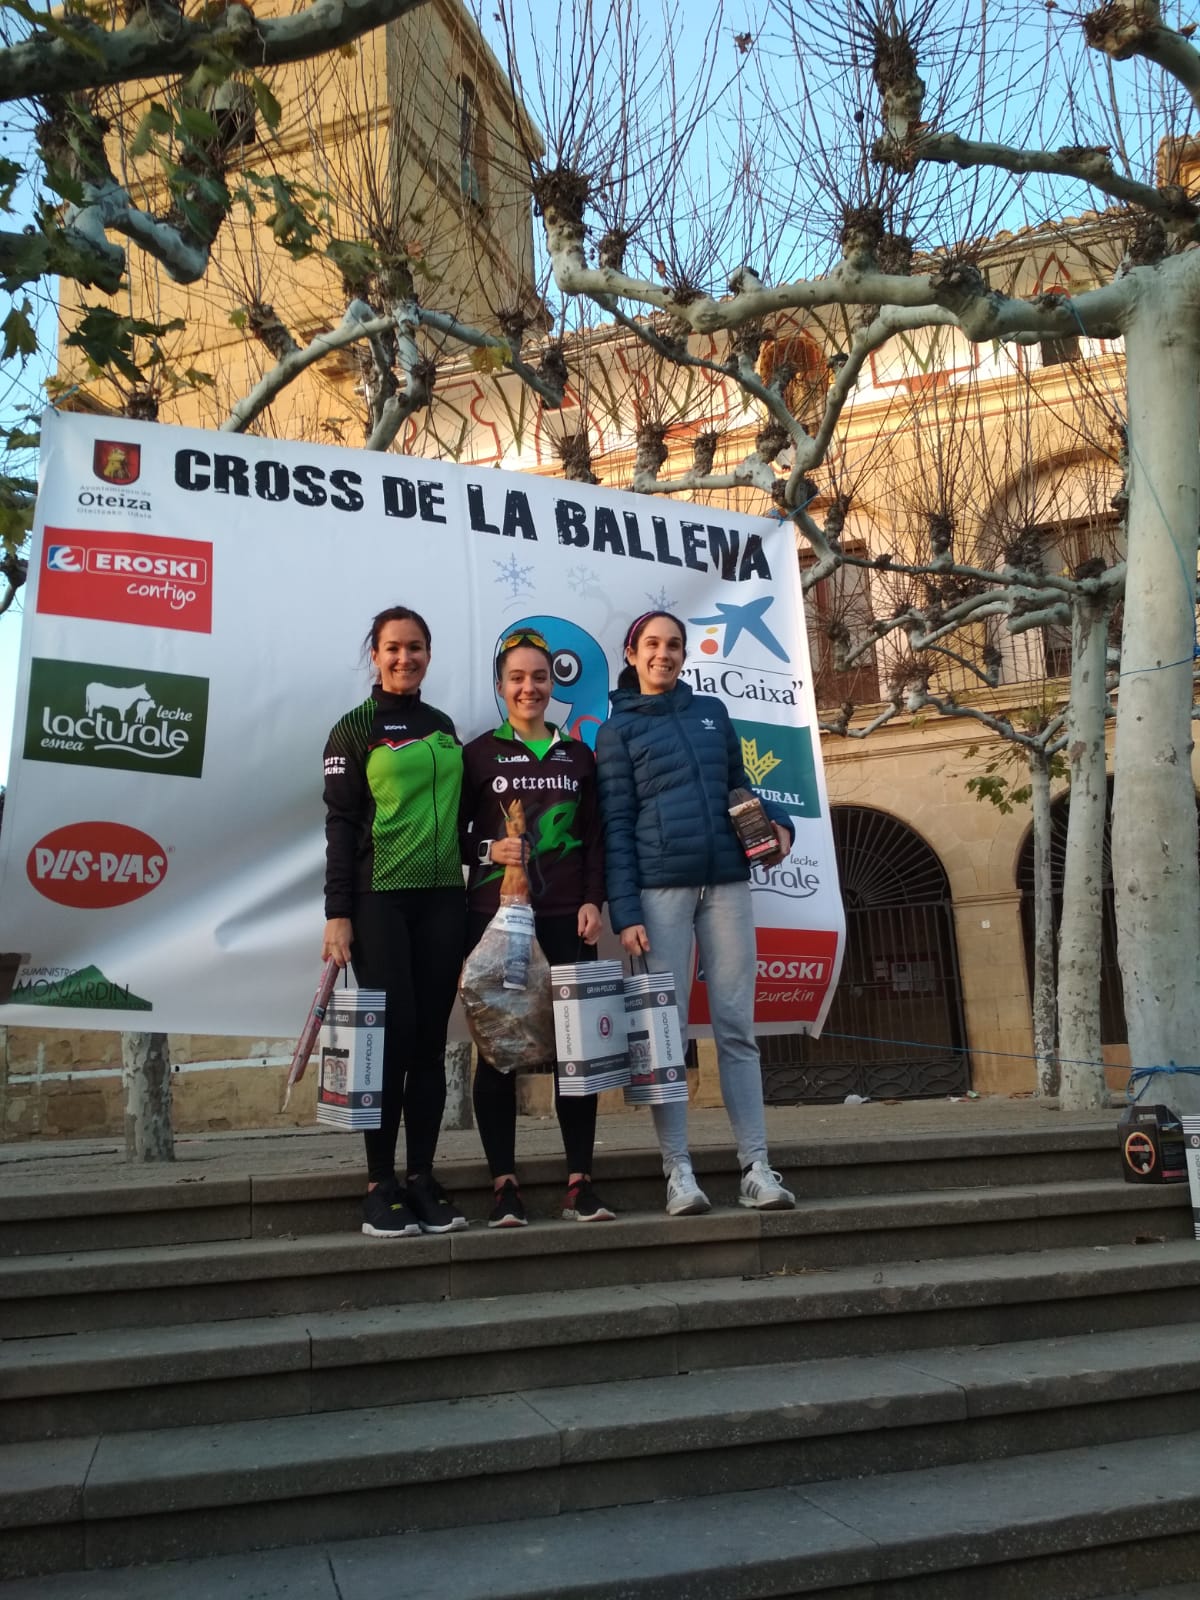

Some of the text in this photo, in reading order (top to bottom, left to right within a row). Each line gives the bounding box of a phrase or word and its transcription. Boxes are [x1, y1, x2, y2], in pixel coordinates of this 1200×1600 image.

[78, 492, 152, 511] Oteiza
[175, 448, 772, 581] CROSS DE LA BALLENA
[96, 553, 198, 579] EROSKI
[127, 581, 196, 610] contigo
[156, 705, 193, 722] leche
[42, 706, 190, 749] lacturale
[40, 737, 85, 751] esnea
[512, 774, 579, 792] etxenike
[790, 854, 819, 867] leche
[757, 989, 815, 1002] zurekin
[364, 1033, 373, 1086] GRAN FEUDO
